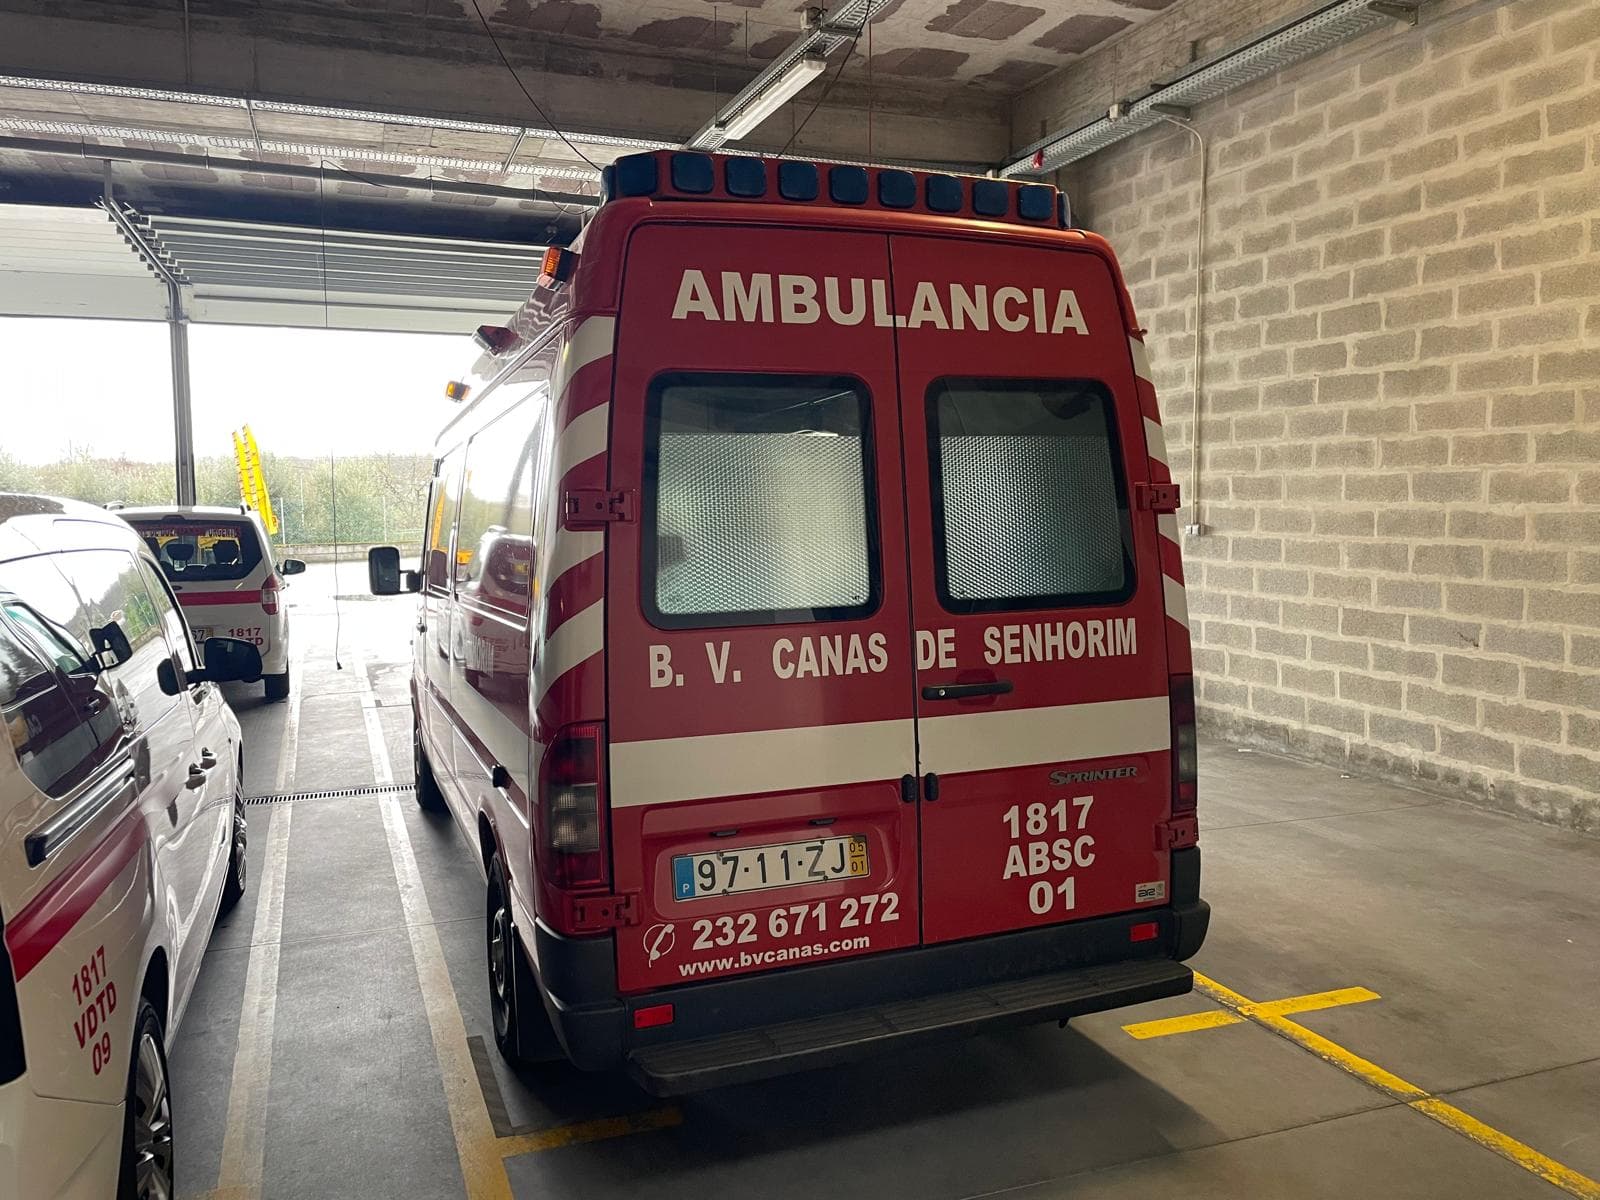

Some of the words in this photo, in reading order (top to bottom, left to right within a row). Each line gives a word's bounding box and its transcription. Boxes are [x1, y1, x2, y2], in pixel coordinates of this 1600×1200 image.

[671, 269, 1090, 335] AMBULANCIA
[228, 627, 262, 637] 1817
[649, 645, 684, 688] B.
[705, 641, 741, 683] V.
[772, 632, 888, 679] CANAS
[916, 628, 957, 670] DE
[983, 617, 1137, 665] SENHORIM
[1002, 795, 1094, 839] 1817
[849, 842, 864, 853] 05
[851, 860, 865, 872] 01
[1003, 835, 1096, 880] ABSC
[682, 883, 690, 893] P
[1028, 876, 1076, 915] 01
[692, 913, 757, 950] 232
[768, 902, 826, 938] 671
[840, 892, 899, 928] 272
[72, 945, 108, 1006] 1817
[679, 936, 870, 977] www.bvcanas.com
[73, 981, 117, 1049] VDTD
[92, 1031, 111, 1076] 09
